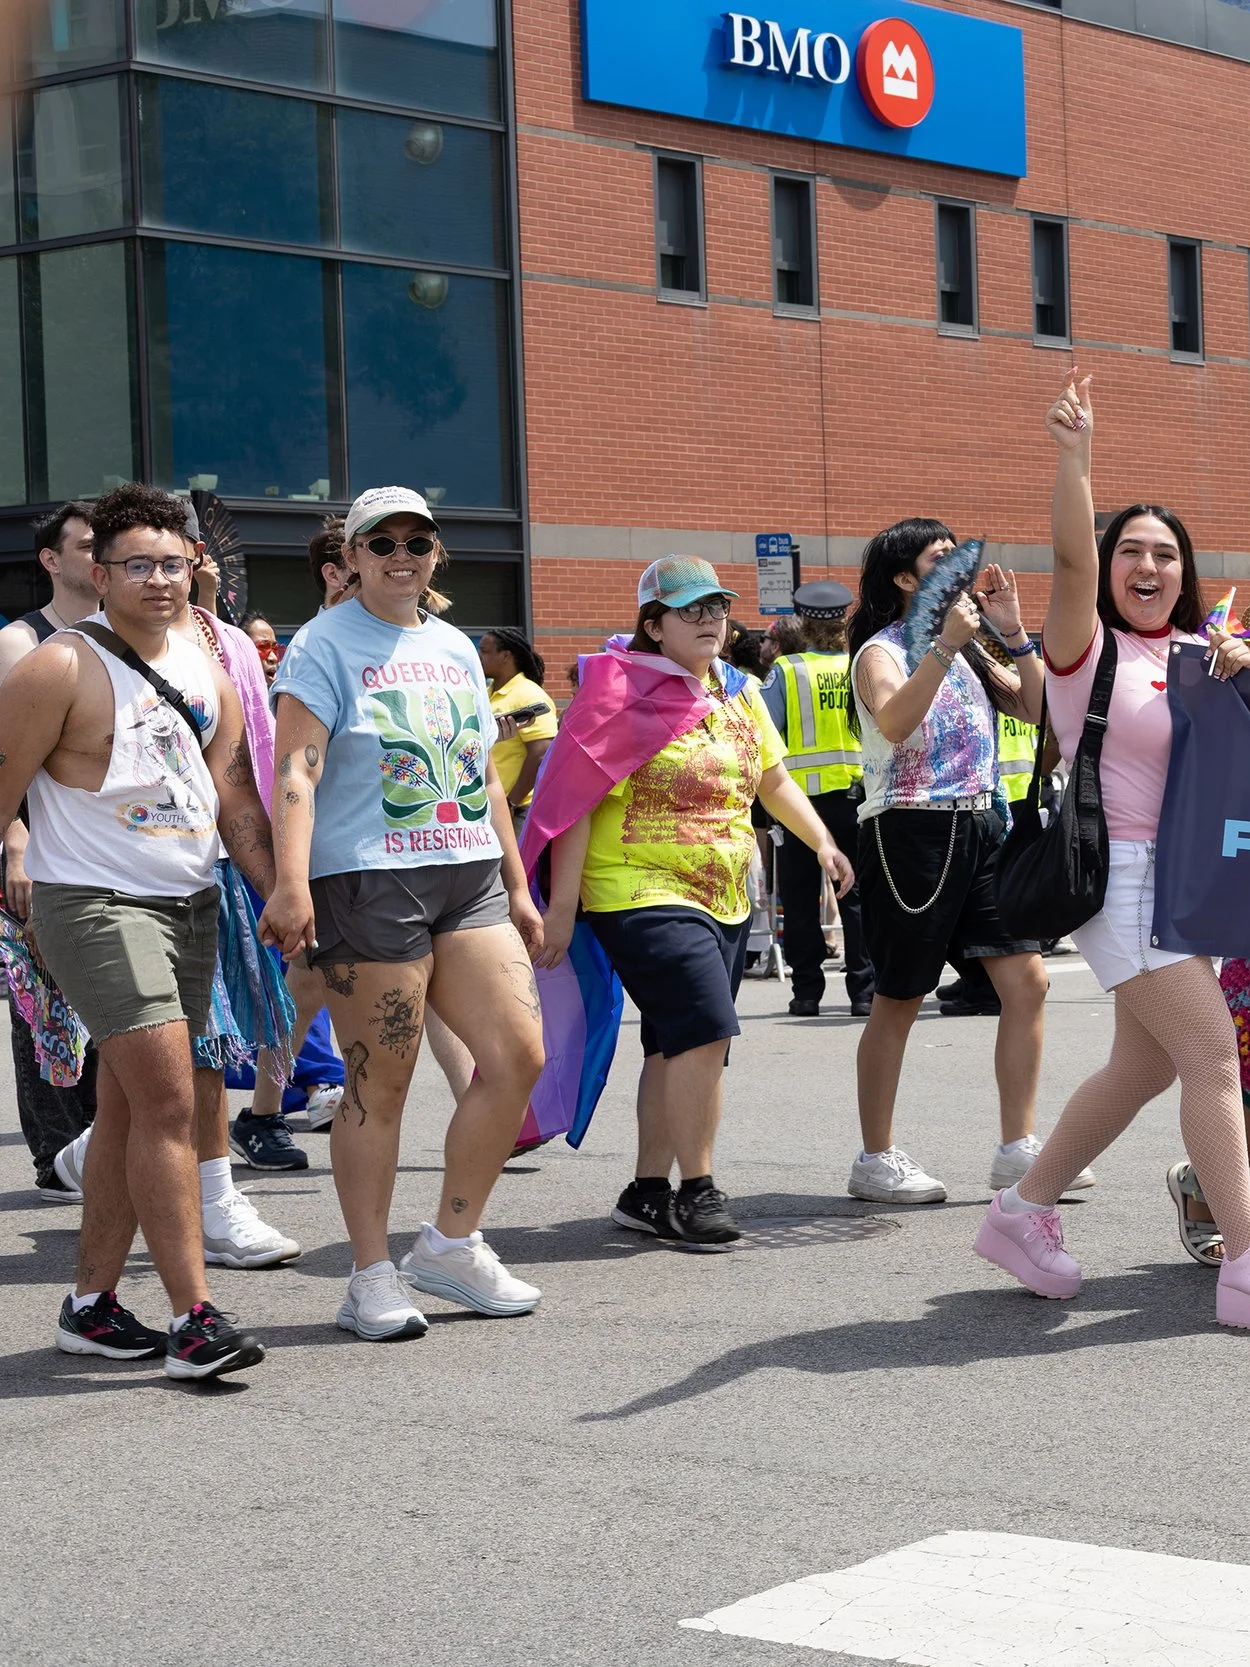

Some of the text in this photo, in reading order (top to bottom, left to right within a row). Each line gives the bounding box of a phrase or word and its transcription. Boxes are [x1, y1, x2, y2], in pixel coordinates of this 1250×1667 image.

[729, 13, 850, 84] BMO
[361, 662, 469, 690] QUEER JOY
[816, 672, 850, 690] CHICA
[385, 825, 492, 854] IS RESISTANCE
